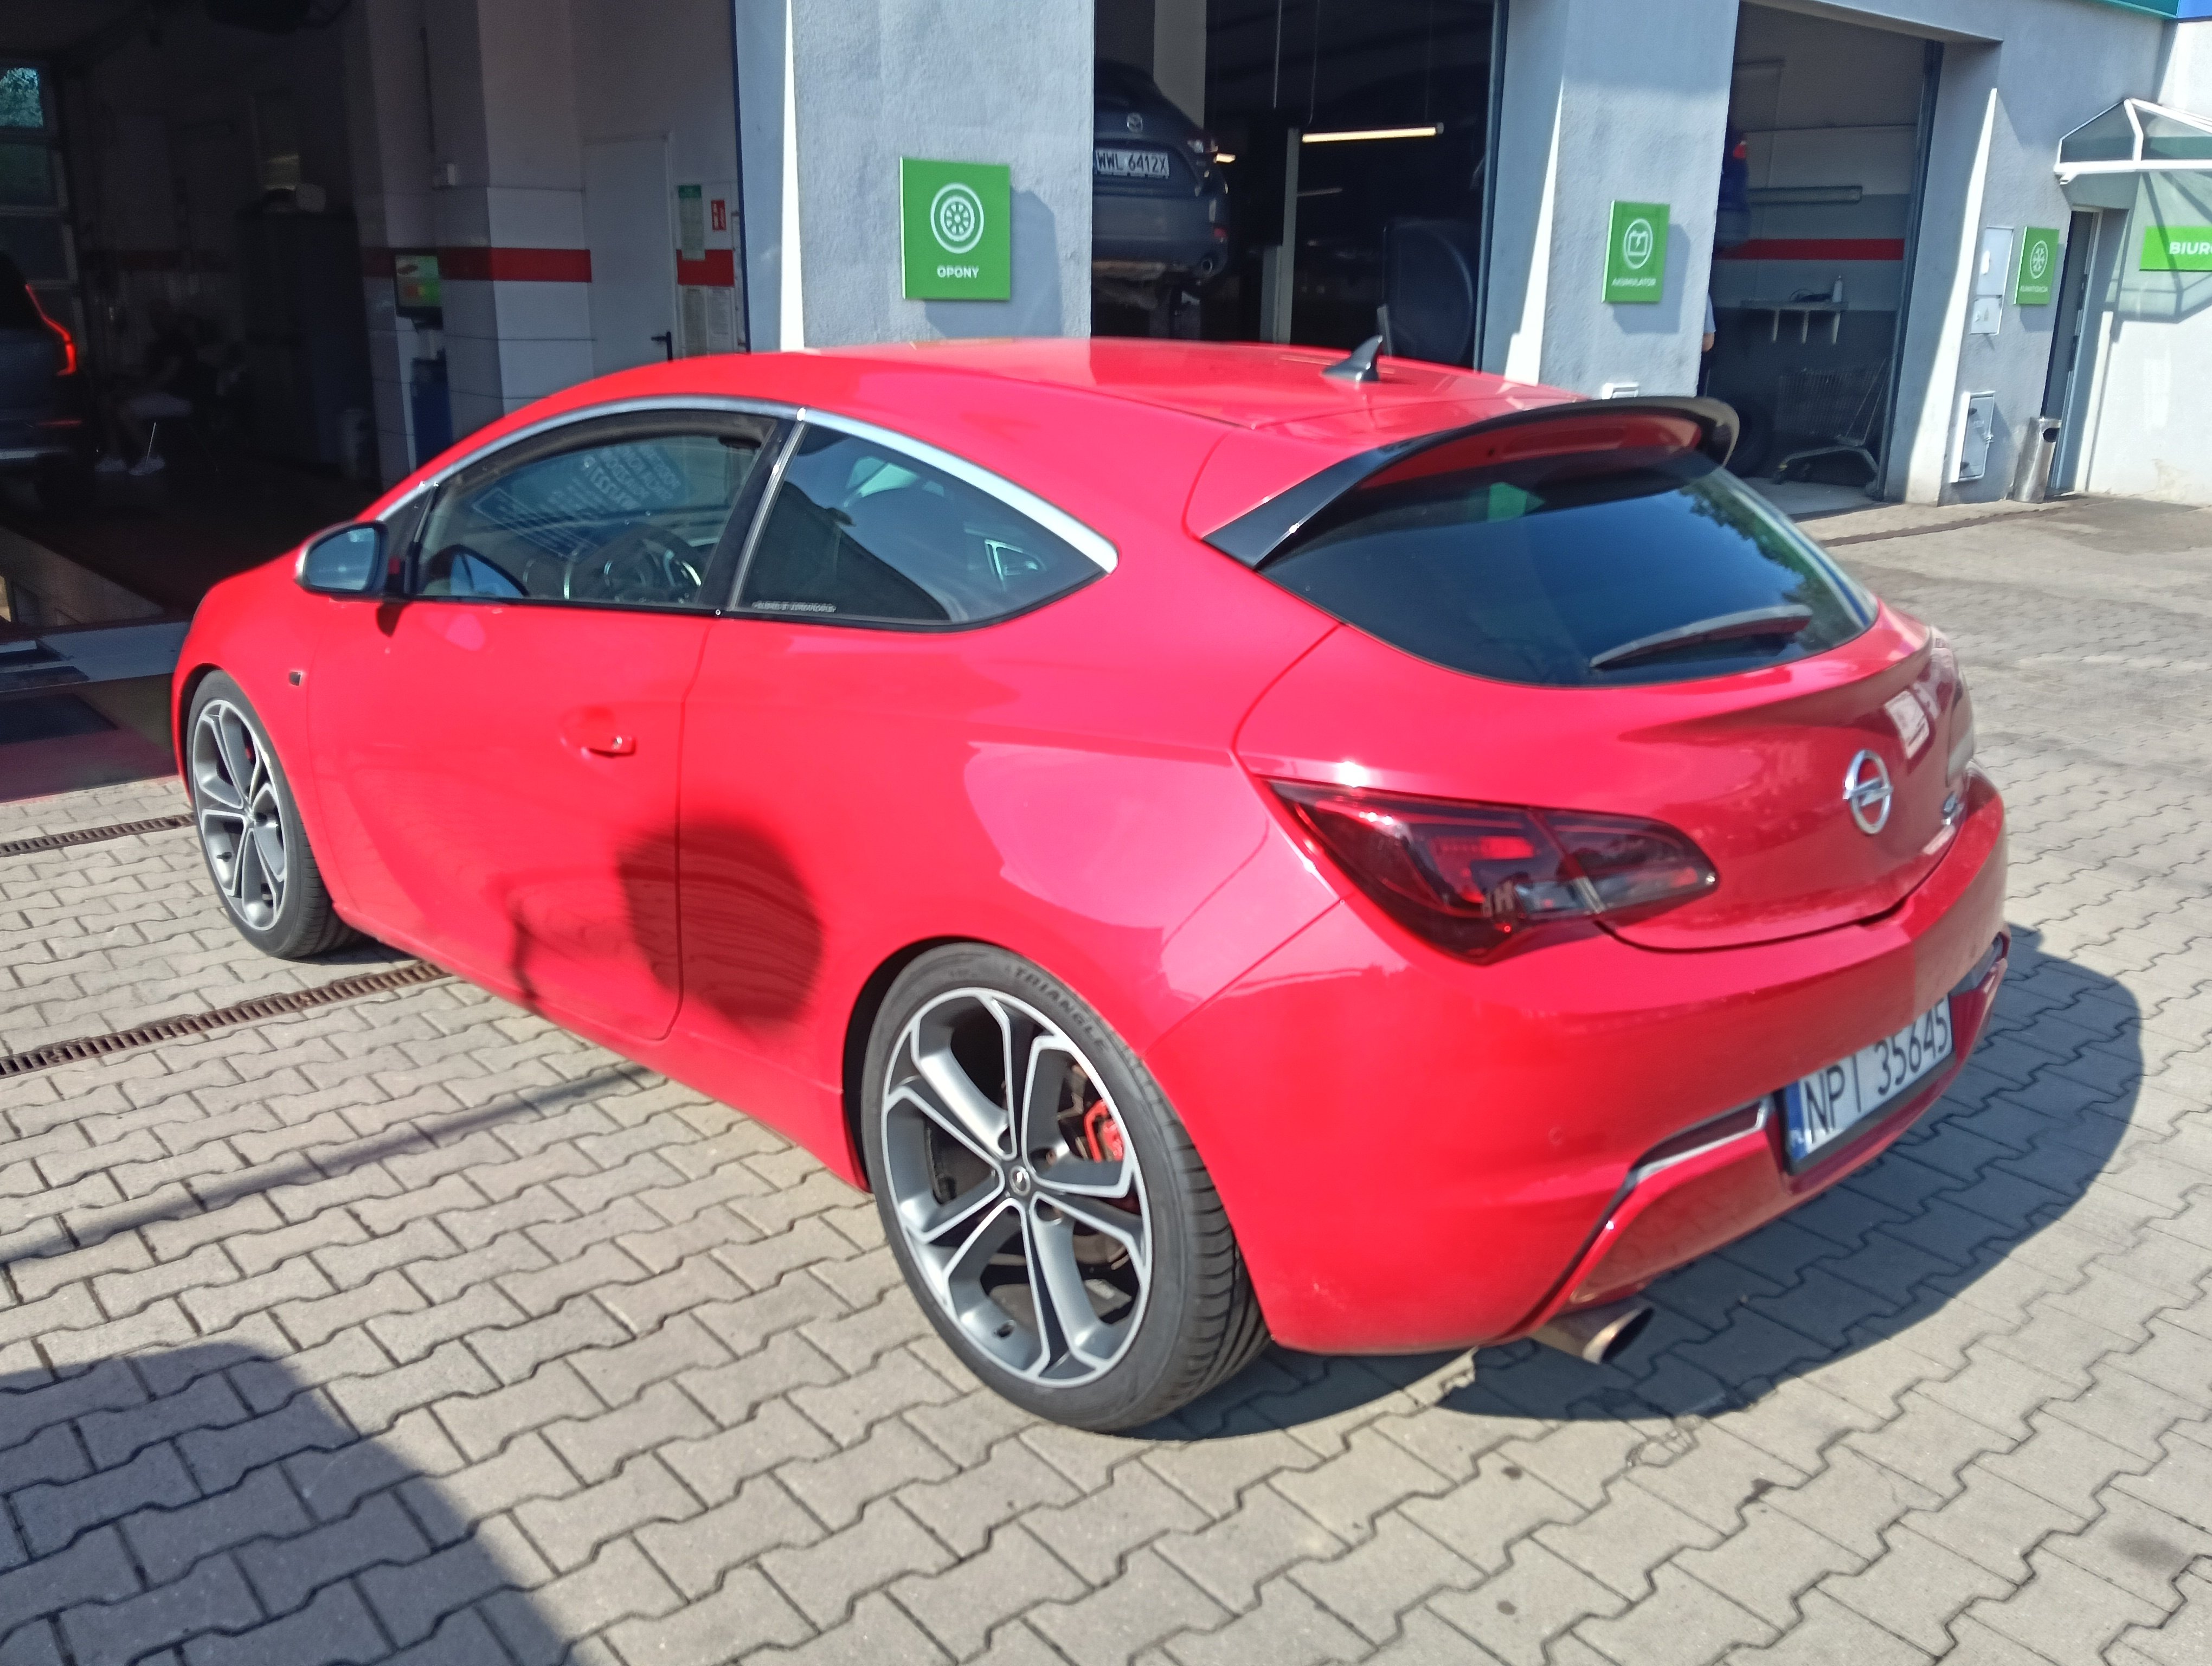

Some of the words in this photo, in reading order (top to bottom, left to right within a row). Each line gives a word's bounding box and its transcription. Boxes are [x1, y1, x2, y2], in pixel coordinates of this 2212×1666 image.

[1097, 152, 1124, 170] WWL
[1128, 154, 1167, 173] 6412X
[2169, 242, 2212, 255] BIUR
[936, 265, 979, 278] OPONY
[1874, 998, 1949, 1095] 35645
